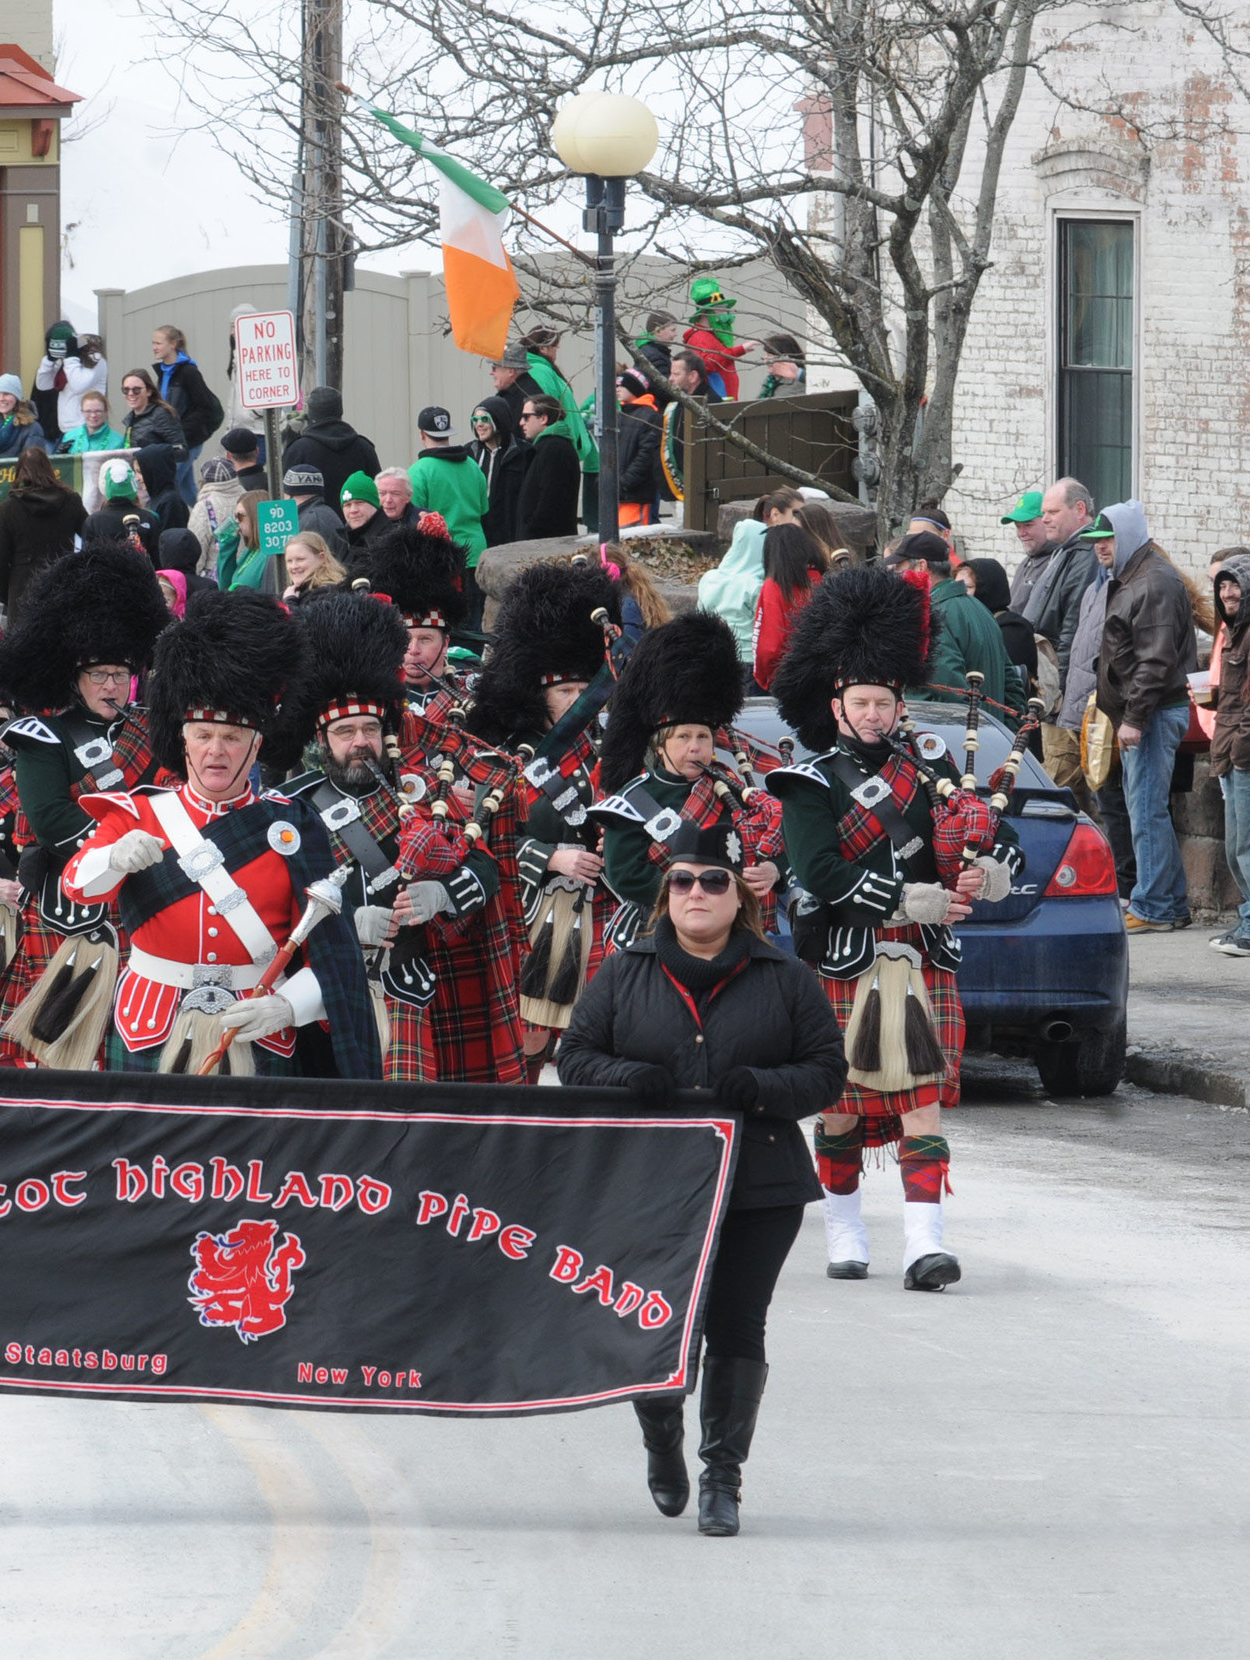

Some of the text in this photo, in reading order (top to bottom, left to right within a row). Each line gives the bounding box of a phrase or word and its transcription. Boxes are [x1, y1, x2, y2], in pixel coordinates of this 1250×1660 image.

[254, 321, 275, 340] NO
[242, 342, 291, 364] PARKING
[245, 366, 290, 382] HERE TO
[249, 384, 290, 400] CORNER
[270, 507, 284, 519] 9D
[264, 520, 292, 534] 8203
[416, 1191, 537, 1260] PIPE
[5, 1342, 167, 1375] Staatsburg
[297, 1362, 423, 1388] New York
